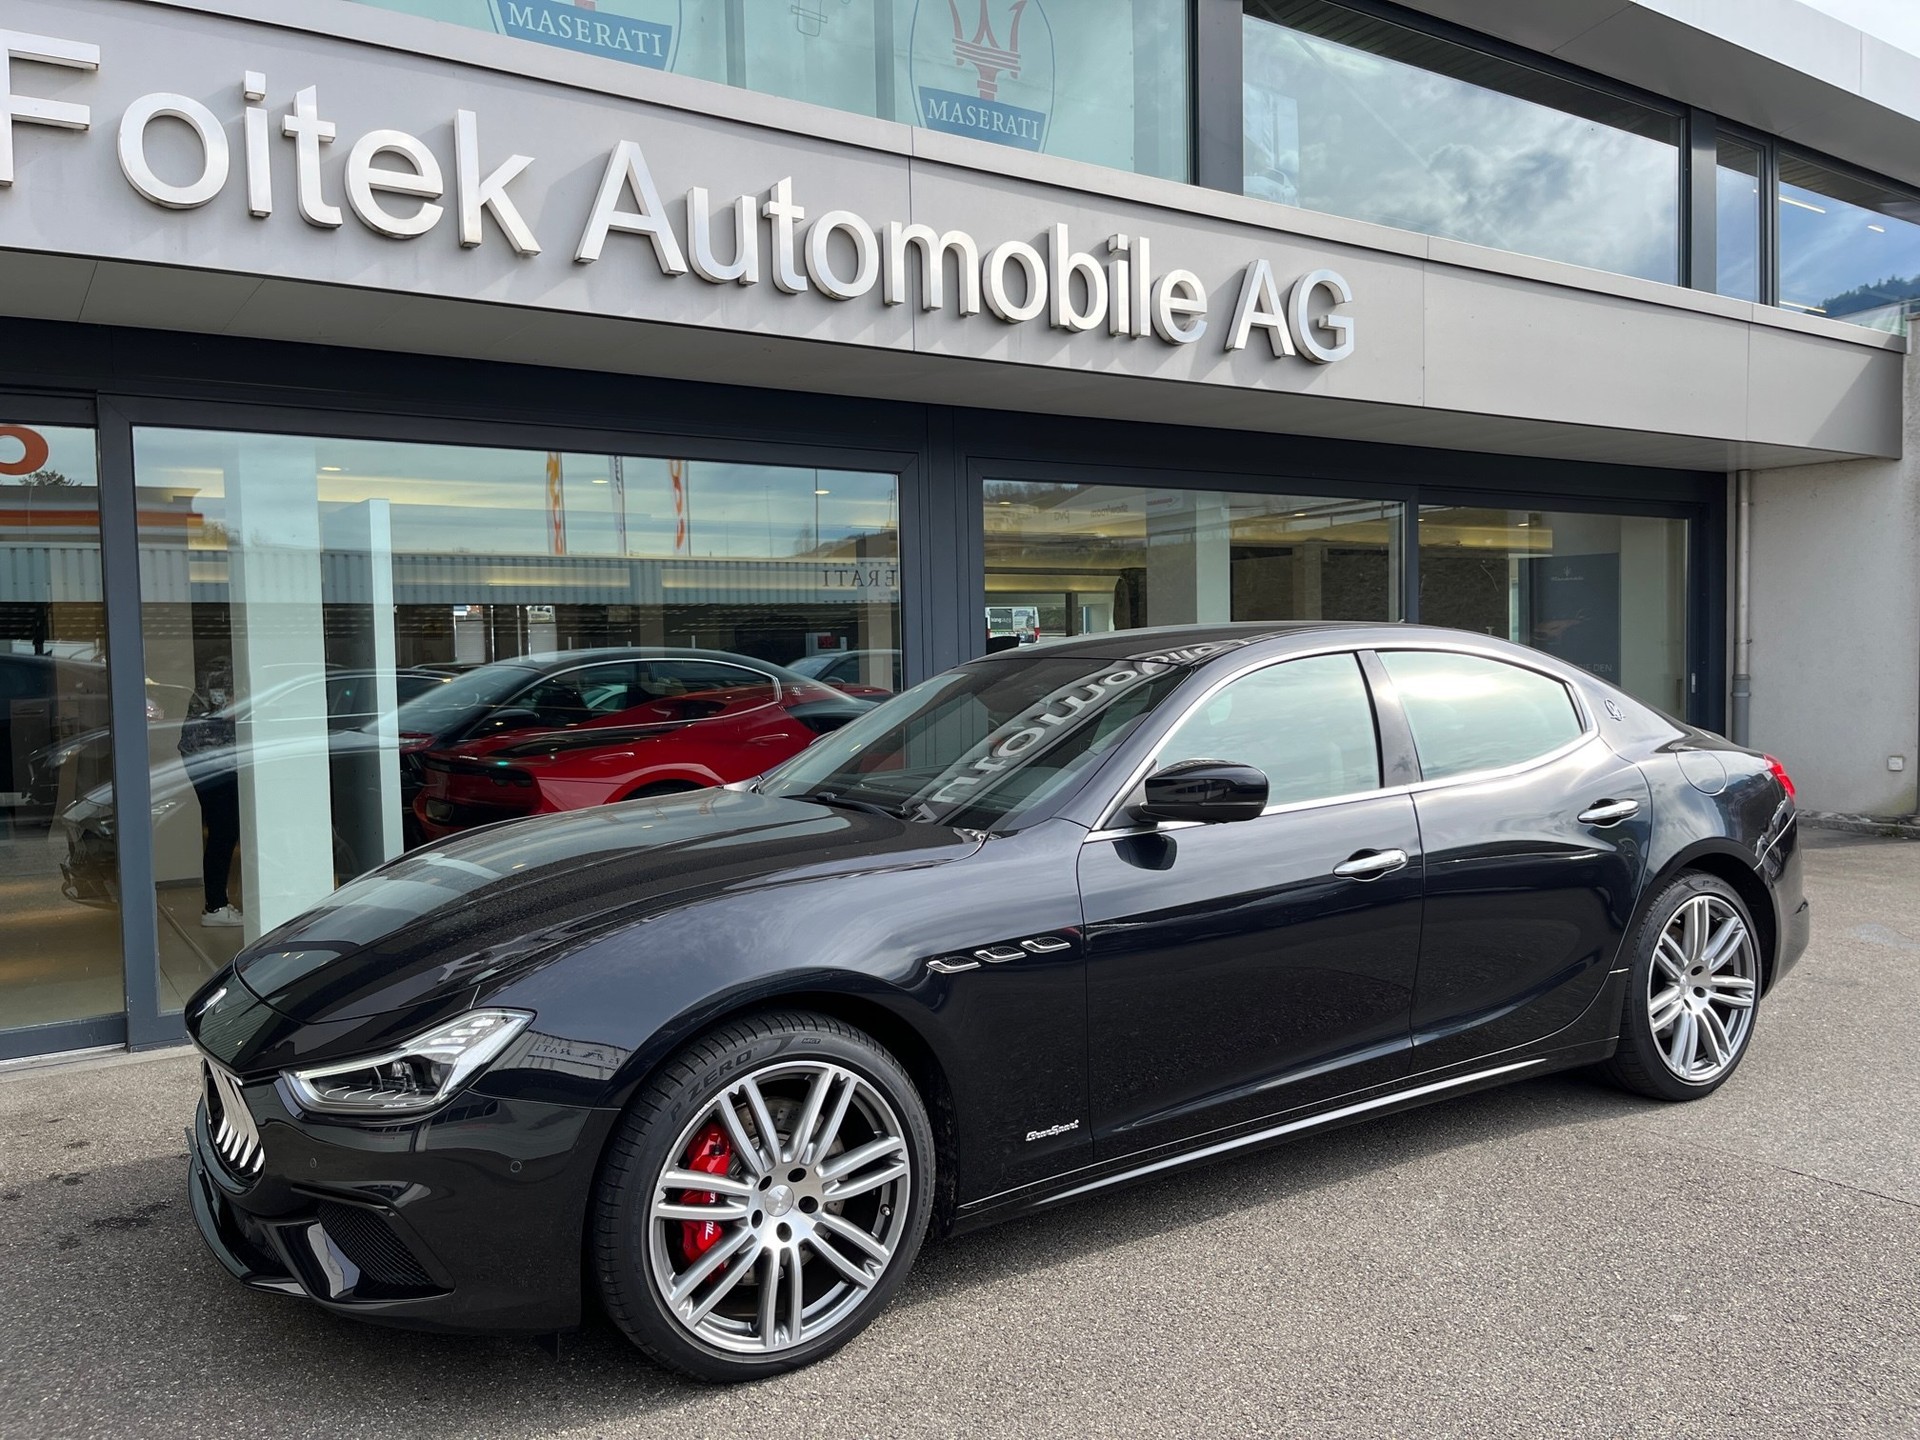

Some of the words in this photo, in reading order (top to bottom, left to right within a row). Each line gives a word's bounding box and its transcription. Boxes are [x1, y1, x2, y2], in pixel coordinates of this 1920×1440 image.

[507, 1, 663, 57] MASERATI
[927, 98, 1040, 141] MASERATI
[0, 29, 542, 257] Foitek
[574, 140, 1207, 345] Automobile
[1226, 259, 1355, 365] AG
[670, 1101, 683, 1123] P
[688, 1050, 753, 1103] ZERO
